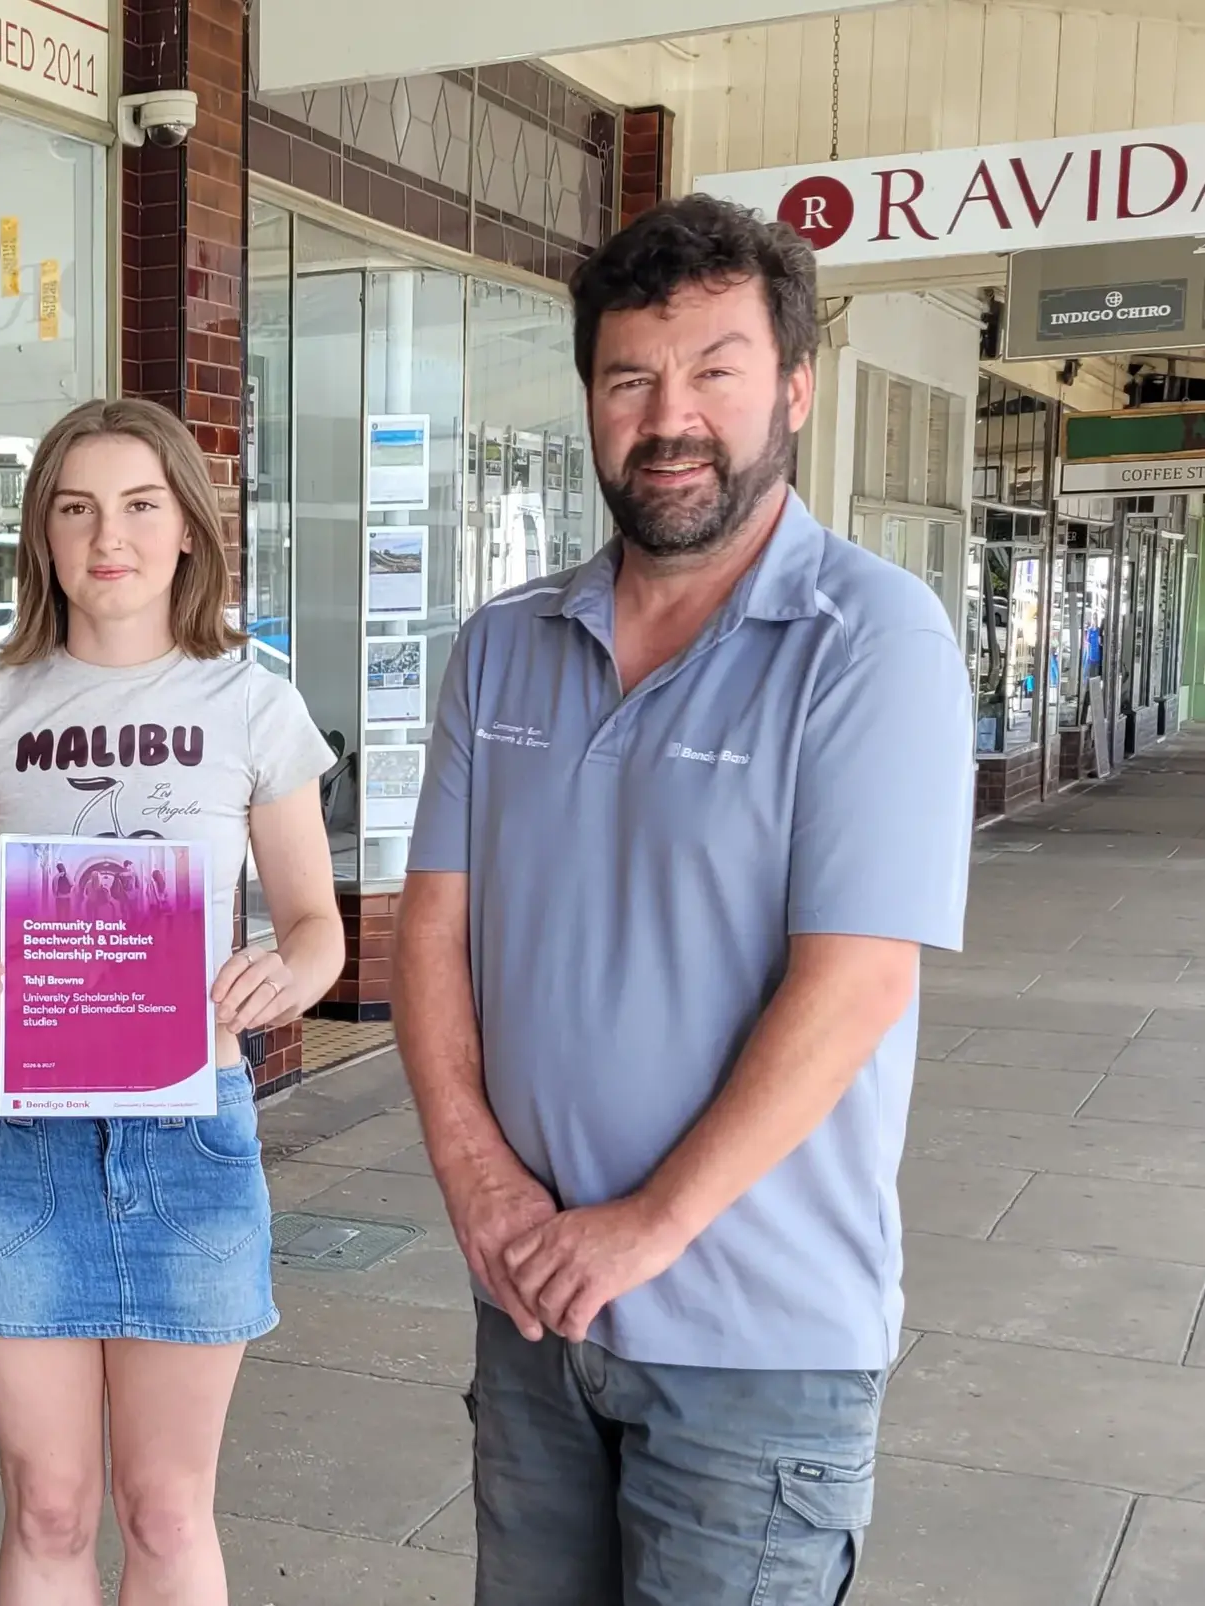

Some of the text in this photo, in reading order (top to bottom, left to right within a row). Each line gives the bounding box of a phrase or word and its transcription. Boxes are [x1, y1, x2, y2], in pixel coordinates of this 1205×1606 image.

[43, 37, 99, 97] 2011
[868, 143, 1205, 242] RAVID
[800, 196, 833, 230] R
[1050, 305, 1172, 325] INDIGO CHIRO
[1122, 466, 1183, 482] COFFEE
[15, 723, 204, 772] MALIBU
[146, 782, 172, 800] Los
[142, 801, 202, 823] Angeles
[23, 919, 126, 933] Community Bank
[24, 934, 154, 946] Beechworth & District
[24, 949, 147, 962] Scholarship Program
[23, 976, 84, 986] Tahji Browne
[23, 992, 145, 1004] University Scholarship for
[23, 1004, 176, 1014] Bachelor of Biomedical Science
[23, 1017, 58, 1026] studies
[26, 1100, 90, 1110] Bendigo Bank
